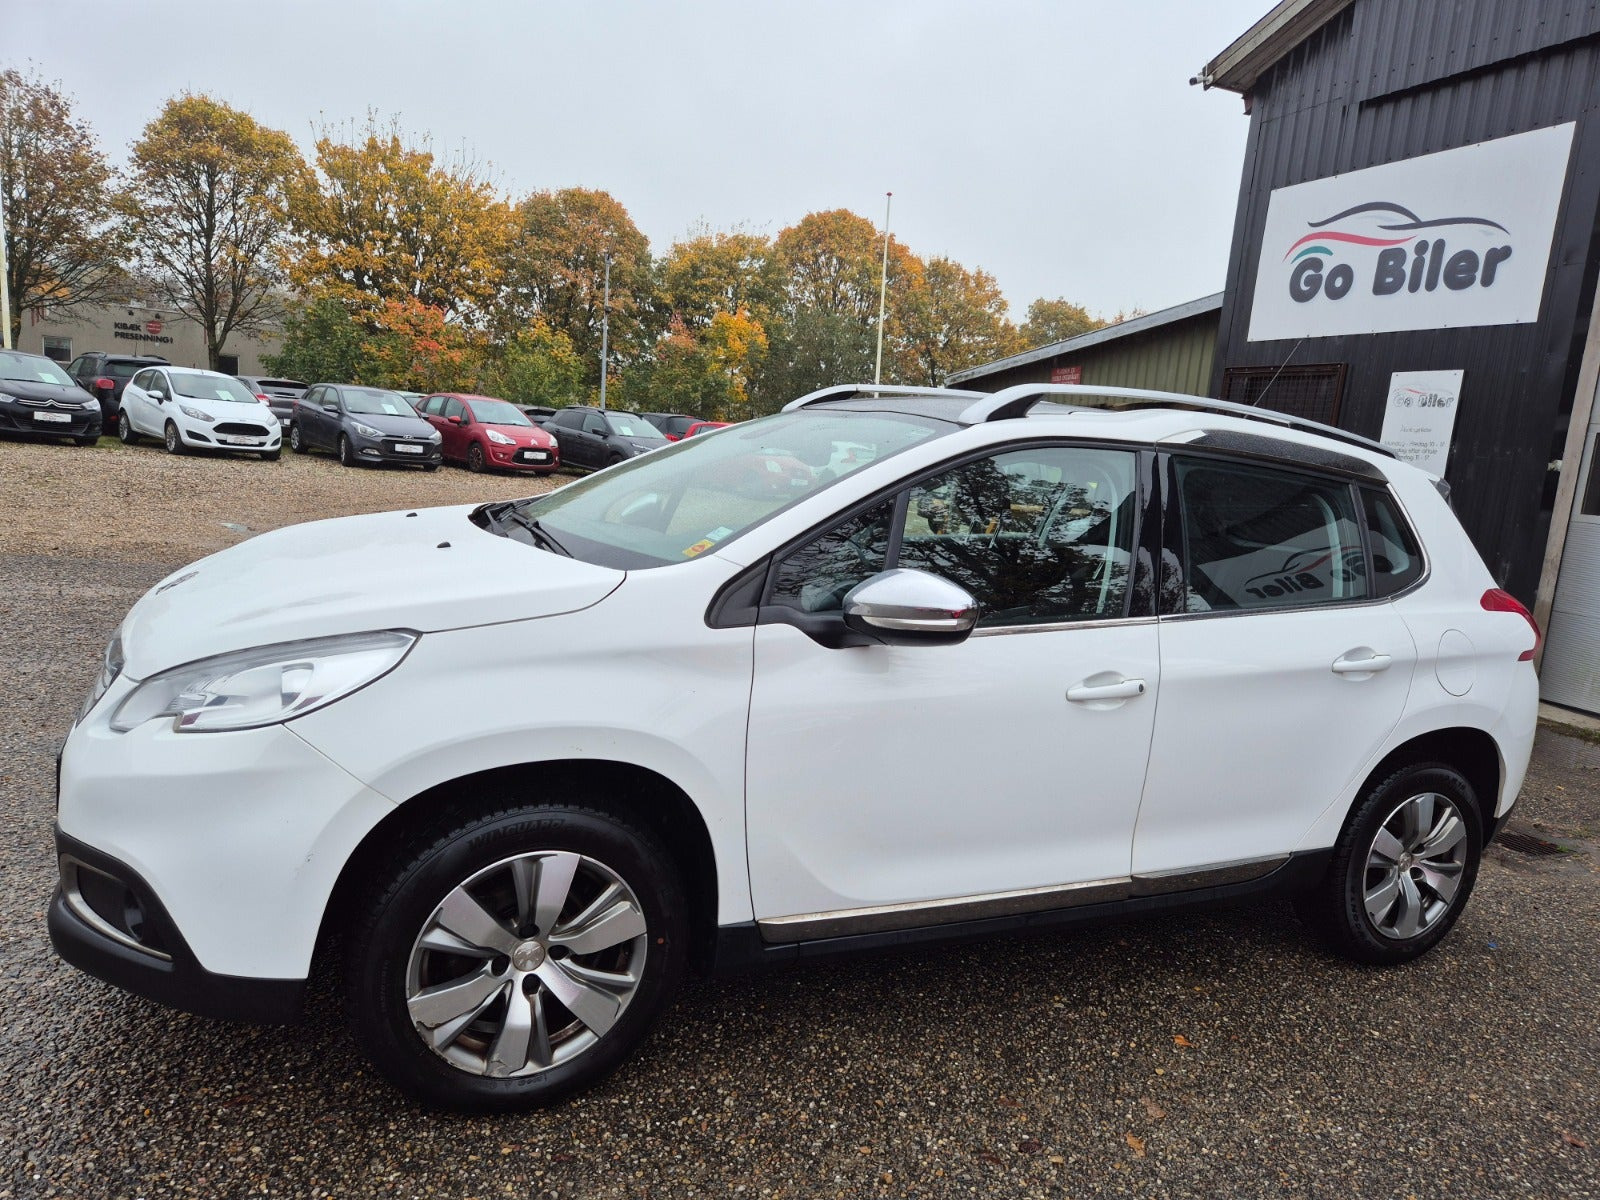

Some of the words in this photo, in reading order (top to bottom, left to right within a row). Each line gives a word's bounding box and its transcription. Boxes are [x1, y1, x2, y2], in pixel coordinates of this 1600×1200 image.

[1289, 257, 1354, 303] Go
[1372, 238, 1513, 296] Biler
[114, 321, 141, 331] KIBÆK
[114, 331, 169, 343] PRESENNING
